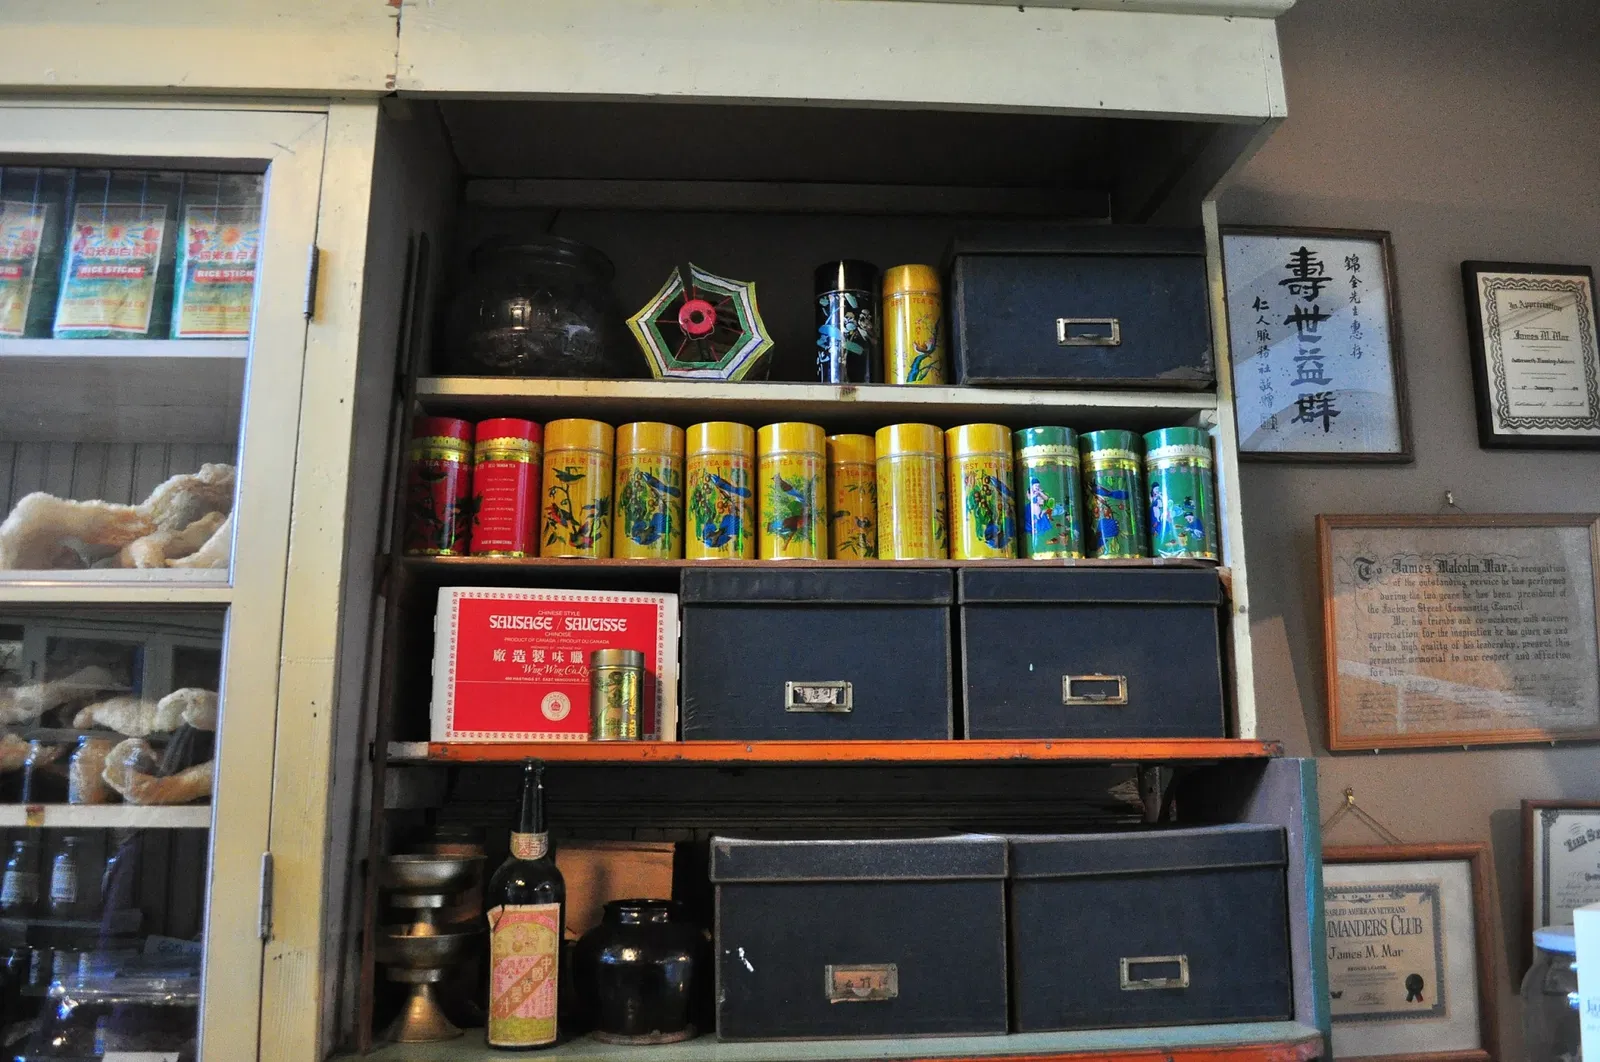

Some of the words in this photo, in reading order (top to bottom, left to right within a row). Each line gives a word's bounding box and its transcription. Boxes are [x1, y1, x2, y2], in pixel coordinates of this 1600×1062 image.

[1514, 330, 1539, 340] James
[1353, 556, 1382, 582] To
[1392, 558, 1431, 574] James
[1433, 557, 1480, 575] Malcolm
[1521, 564, 1566, 575] recognition
[1404, 578, 1415, 586] the
[1419, 578, 1468, 588] outstanding
[1470, 578, 1499, 586] service
[1528, 576, 1566, 587] performed
[1380, 593, 1406, 602] during
[1492, 589, 1512, 598] been
[1517, 588, 1556, 600] president
[1367, 604, 1380, 614] the
[1382, 603, 1416, 614] Jackson
[1417, 602, 1442, 613] Street
[1446, 602, 1488, 614] Community
[489, 615, 553, 630] SAUSAGE
[564, 618, 628, 632] SAUCISSE
[1428, 615, 1455, 625] friends
[1368, 628, 1418, 640] appreciation
[1422, 627, 1435, 638] for
[1438, 628, 1448, 638] the
[1506, 626, 1518, 636] has
[1520, 627, 1541, 638] given
[1368, 642, 1381, 652] for
[1385, 642, 1396, 652] the
[1400, 641, 1418, 654] high
[1420, 640, 1448, 652] quality
[1451, 640, 1460, 650] of
[1522, 640, 1552, 649] present
[1555, 638, 1571, 648] this
[1369, 655, 1407, 666] permanent
[1408, 653, 1446, 663] memorial
[1482, 652, 1510, 663] respect
[1515, 651, 1530, 660] and
[1534, 649, 1572, 660] affection
[522, 664, 543, 676] Wing
[544, 664, 564, 676] Wing
[1369, 667, 1382, 676] for
[1348, 908, 1376, 916] AMERICAN
[1376, 906, 1406, 915] VETERANS
[1391, 914, 1422, 936] CLUB
[1328, 946, 1362, 960] James
[1365, 945, 1378, 958] M.
[1382, 944, 1404, 958] Mar
